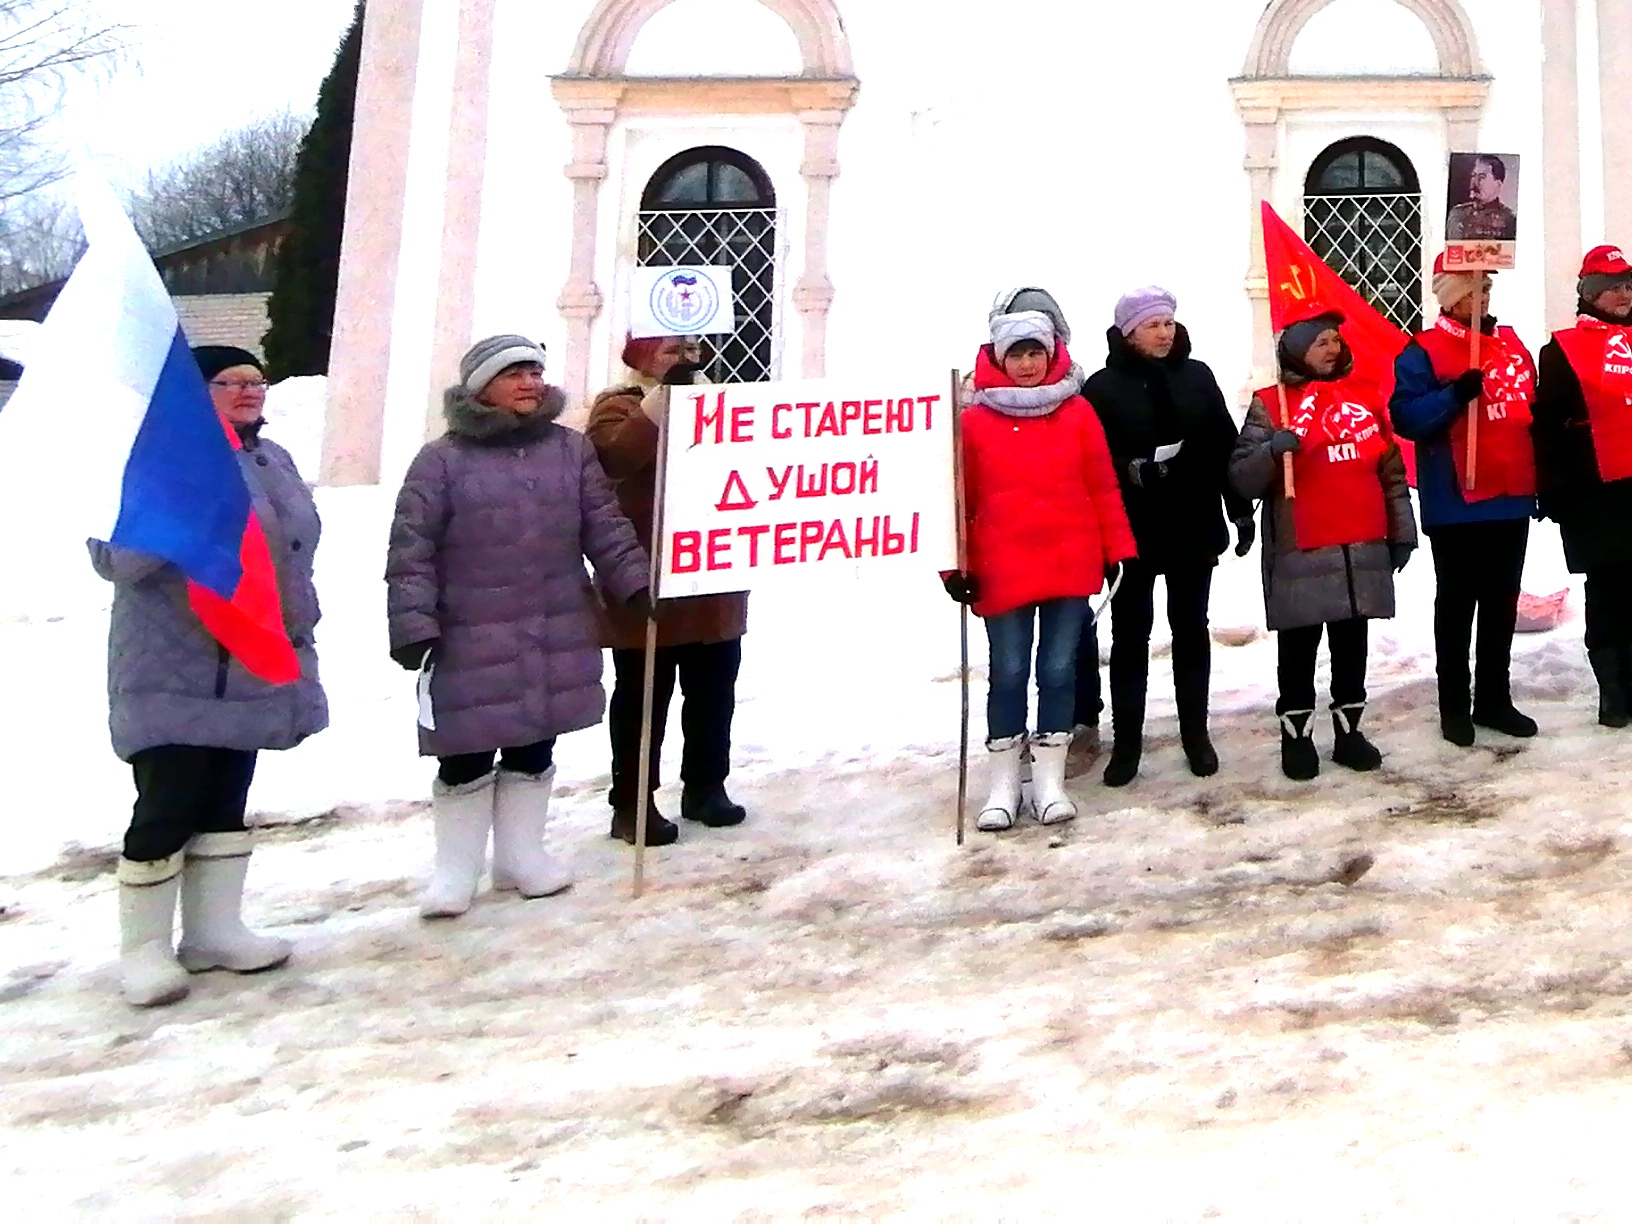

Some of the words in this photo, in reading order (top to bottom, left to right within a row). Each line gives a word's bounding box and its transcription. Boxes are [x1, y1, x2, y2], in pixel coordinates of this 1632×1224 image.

[771, 395, 941, 440] СТАРЕЮТ
[1327, 443, 1358, 463] КП
[671, 512, 920, 575] ВЕТЕРАНЫ
